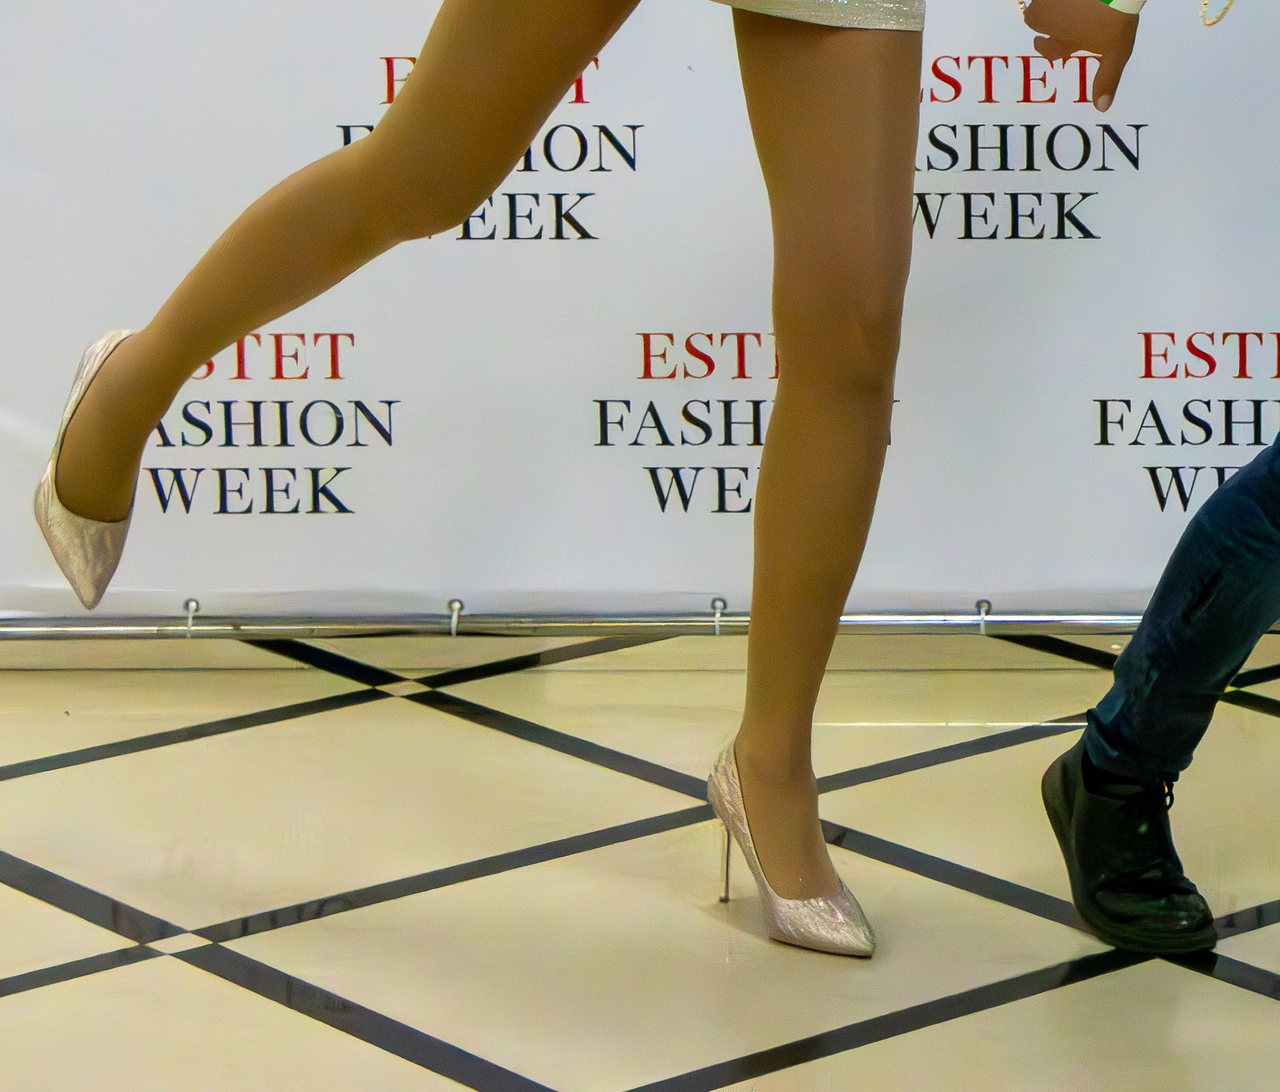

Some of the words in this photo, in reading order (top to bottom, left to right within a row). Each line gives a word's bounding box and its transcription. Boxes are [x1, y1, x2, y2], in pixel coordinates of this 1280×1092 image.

[920, 55, 1103, 104] STET
[915, 124, 1149, 172] SHION
[456, 192, 600, 240] EEK
[191, 333, 355, 380] TET
[636, 332, 779, 380] EST
[156, 400, 401, 448] SHION
[593, 399, 773, 447] FASH
[142, 467, 355, 515] WEEK
[642, 467, 760, 513] WE
